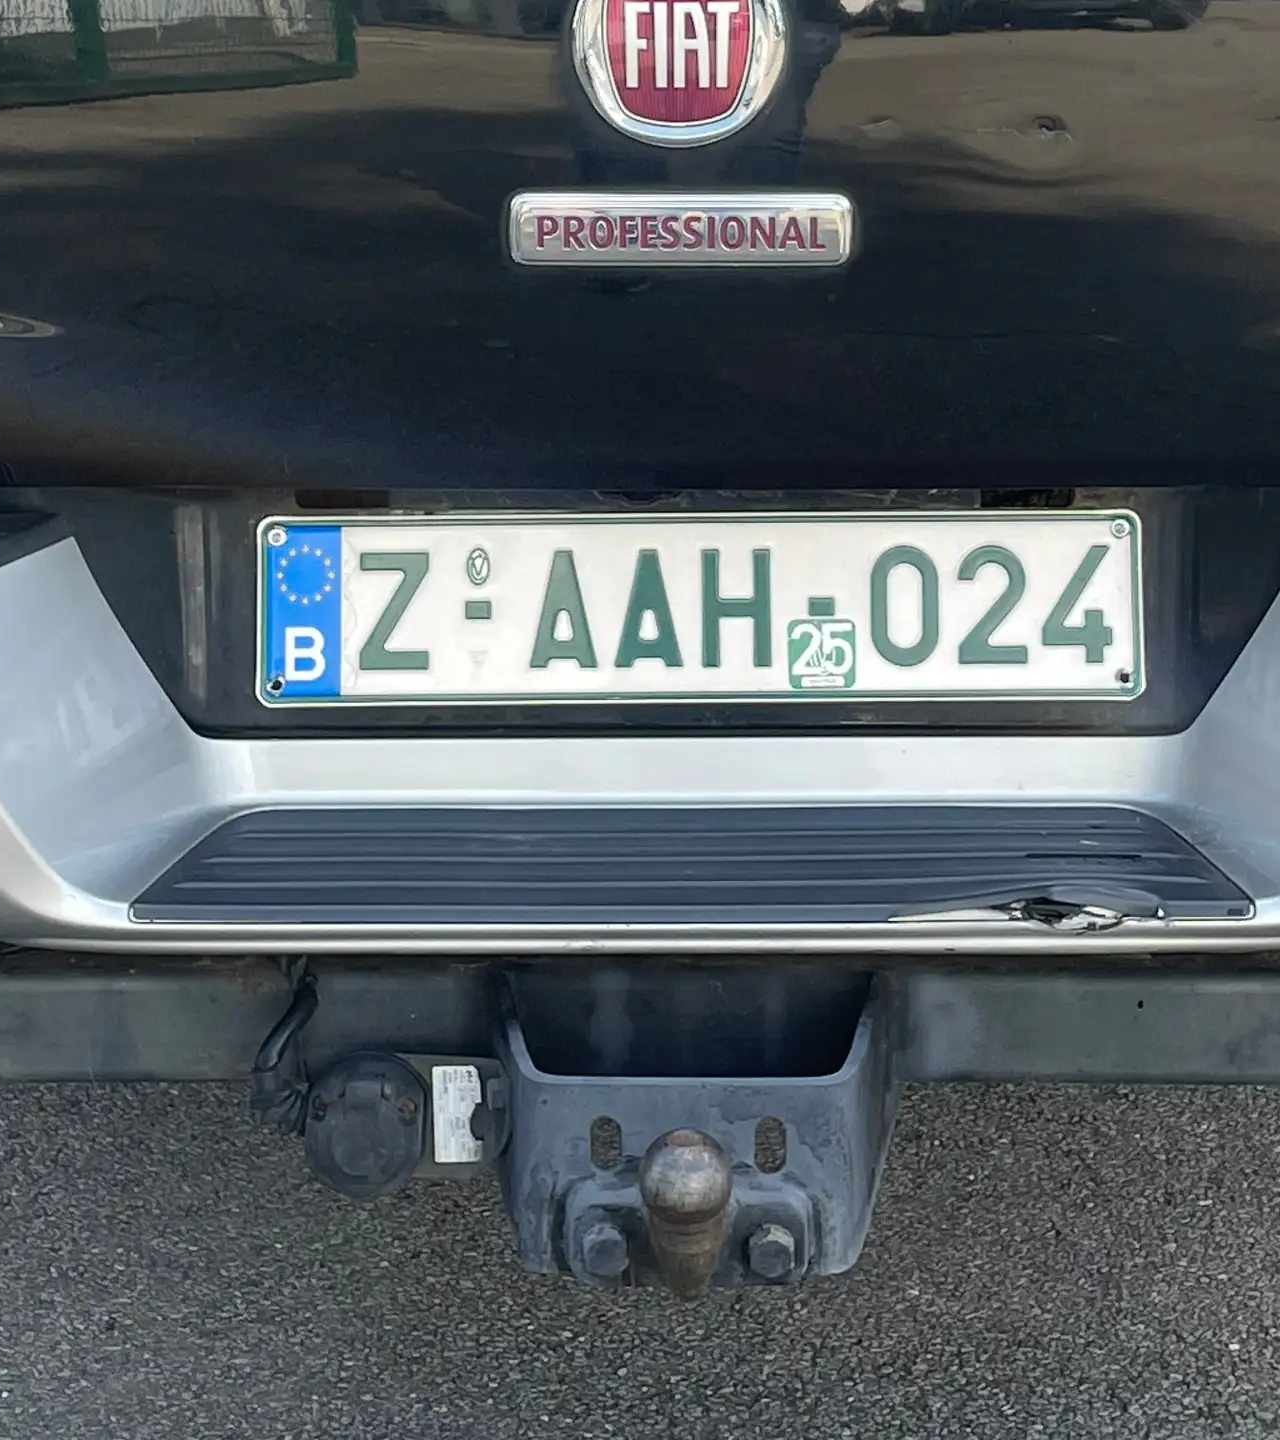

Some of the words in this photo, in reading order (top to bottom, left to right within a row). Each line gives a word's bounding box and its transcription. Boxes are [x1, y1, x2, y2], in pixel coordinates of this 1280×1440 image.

[623, 1, 740, 89] FIAT
[535, 216, 826, 250] PROFESSIONAL
[286, 627, 326, 682] B
[790, 622, 854, 675] 25
